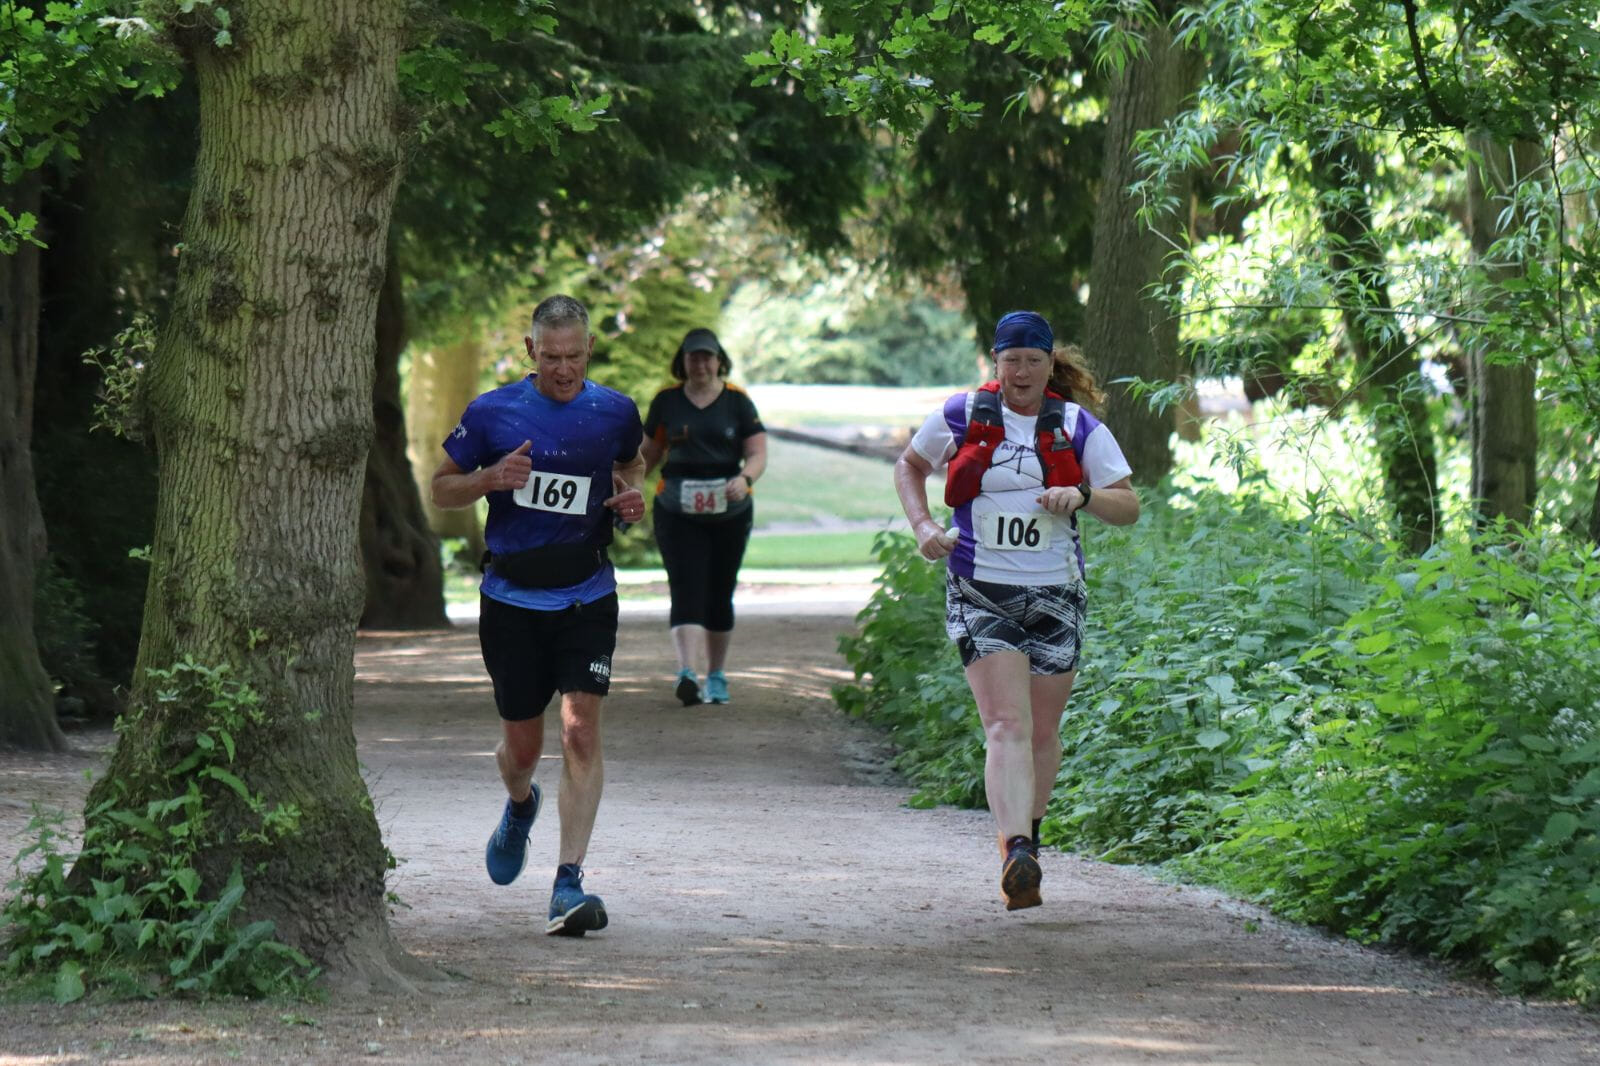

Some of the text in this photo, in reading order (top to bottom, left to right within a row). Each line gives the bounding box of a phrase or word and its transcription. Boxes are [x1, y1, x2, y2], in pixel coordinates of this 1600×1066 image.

[531, 476, 578, 510] 169
[694, 491, 717, 513] 84
[997, 516, 1040, 548] 106
